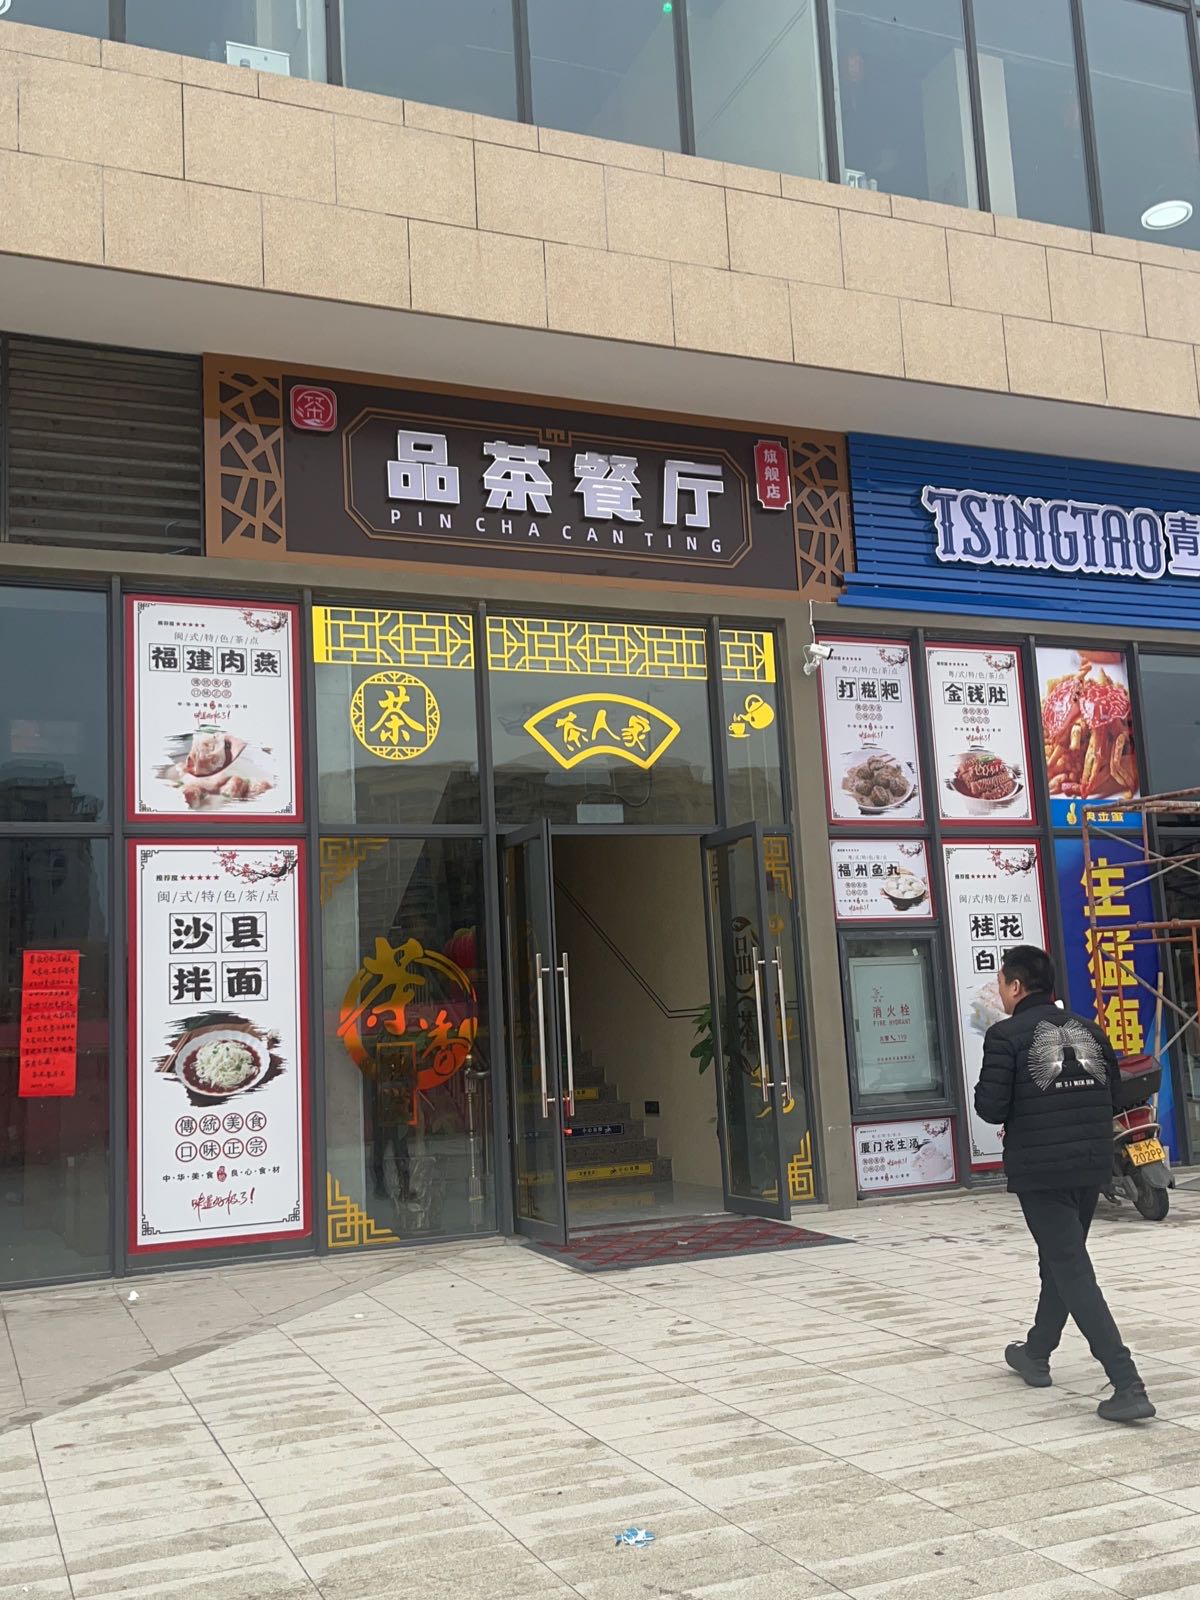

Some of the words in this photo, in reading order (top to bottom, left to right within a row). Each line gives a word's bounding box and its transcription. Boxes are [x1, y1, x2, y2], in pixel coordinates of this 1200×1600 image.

[387, 429, 724, 528] 品茶餐厅
[763, 448, 781, 499] 旗舰店
[390, 509, 452, 529] PIN
[475, 517, 541, 537] CHA
[925, 490, 1163, 575] TSINGTAO
[1168, 516, 1200, 557] 青
[151, 646, 279, 674] 福建肉燕
[838, 679, 900, 701] 打糍粑
[944, 683, 1007, 704] 金钱肚
[369, 685, 426, 745] 茶
[556, 709, 651, 752] 茶人家
[838, 863, 900, 877] 福州鱼丸
[172, 915, 264, 950] 沙县
[971, 915, 1022, 939] 桂花
[975, 949, 996, 971] 白
[172, 966, 263, 1001] 拌面
[872, 1004, 911, 1018] 消火栓
[177, 1138, 266, 1161] 口味正宗
[1133, 1148, 1162, 1165] 202PP
